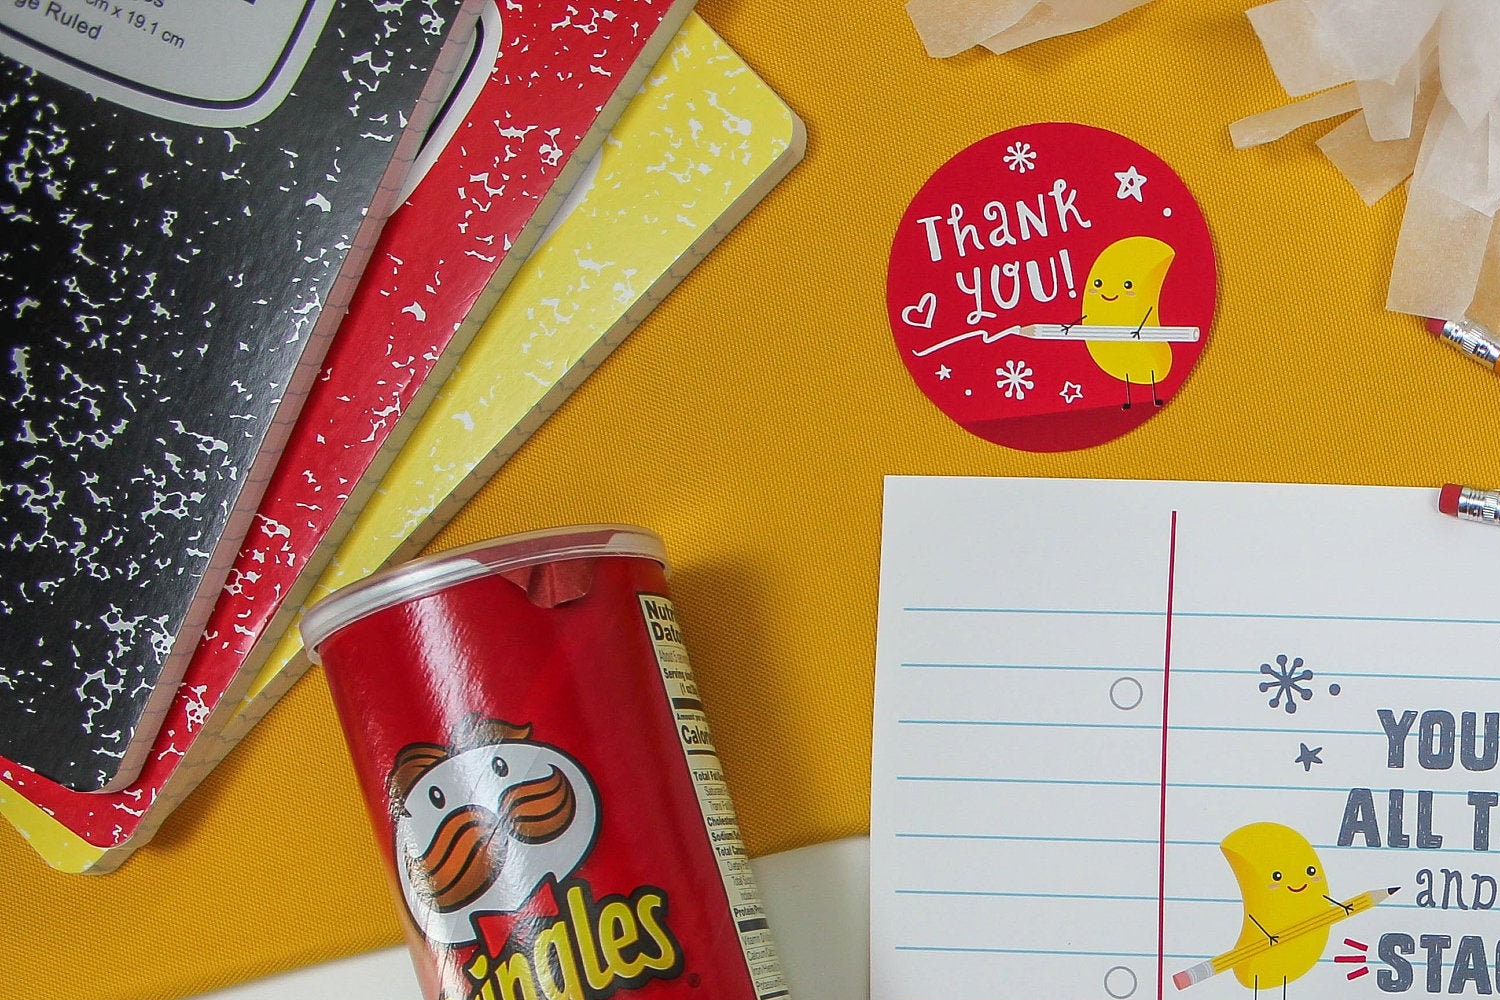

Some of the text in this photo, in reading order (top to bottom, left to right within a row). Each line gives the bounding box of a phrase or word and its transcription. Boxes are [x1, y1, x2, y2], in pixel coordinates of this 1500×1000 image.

[45, 1, 102, 40] Ruled
[127, 11, 158, 35] 19.1
[162, 31, 185, 48] cm
[1337, 788, 1443, 849] ALL
